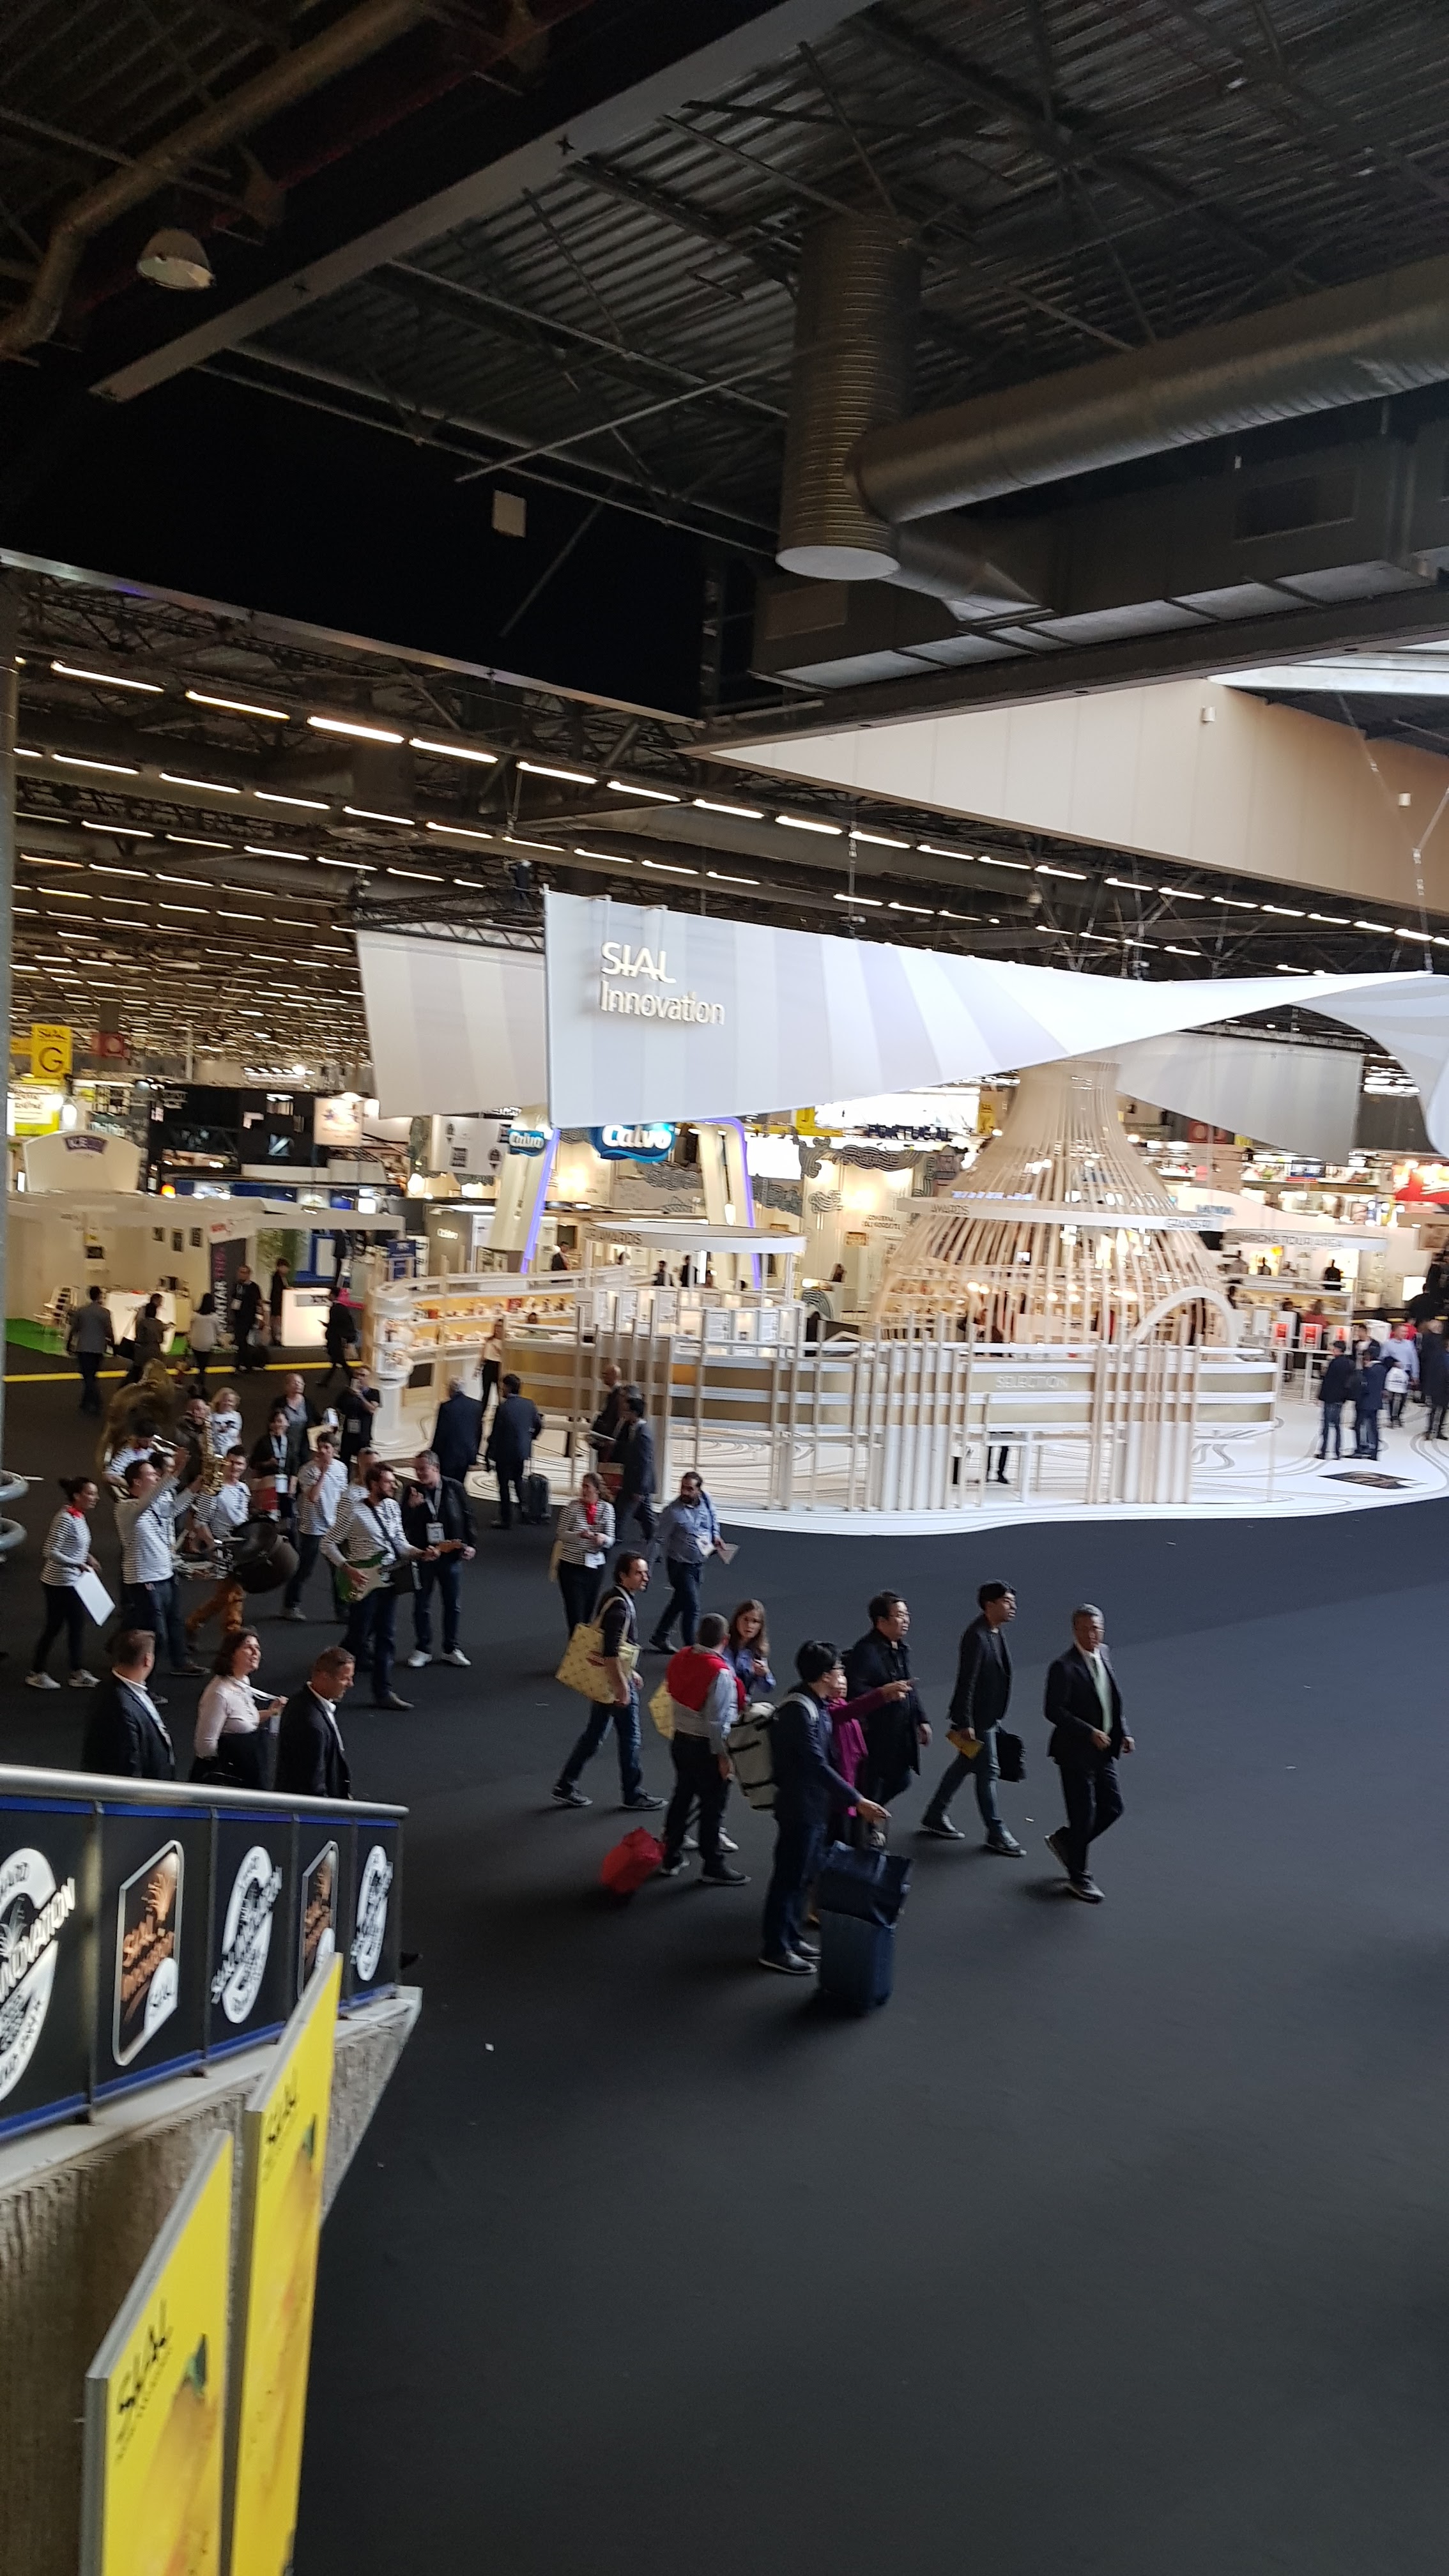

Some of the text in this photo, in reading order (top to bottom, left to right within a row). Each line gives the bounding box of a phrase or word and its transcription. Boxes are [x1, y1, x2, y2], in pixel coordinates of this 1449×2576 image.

[601, 942, 677, 984] SIAL
[601, 980, 726, 1025] Innovation
[38, 1046, 63, 1073] G
[602, 1124, 671, 1149] Calvo
